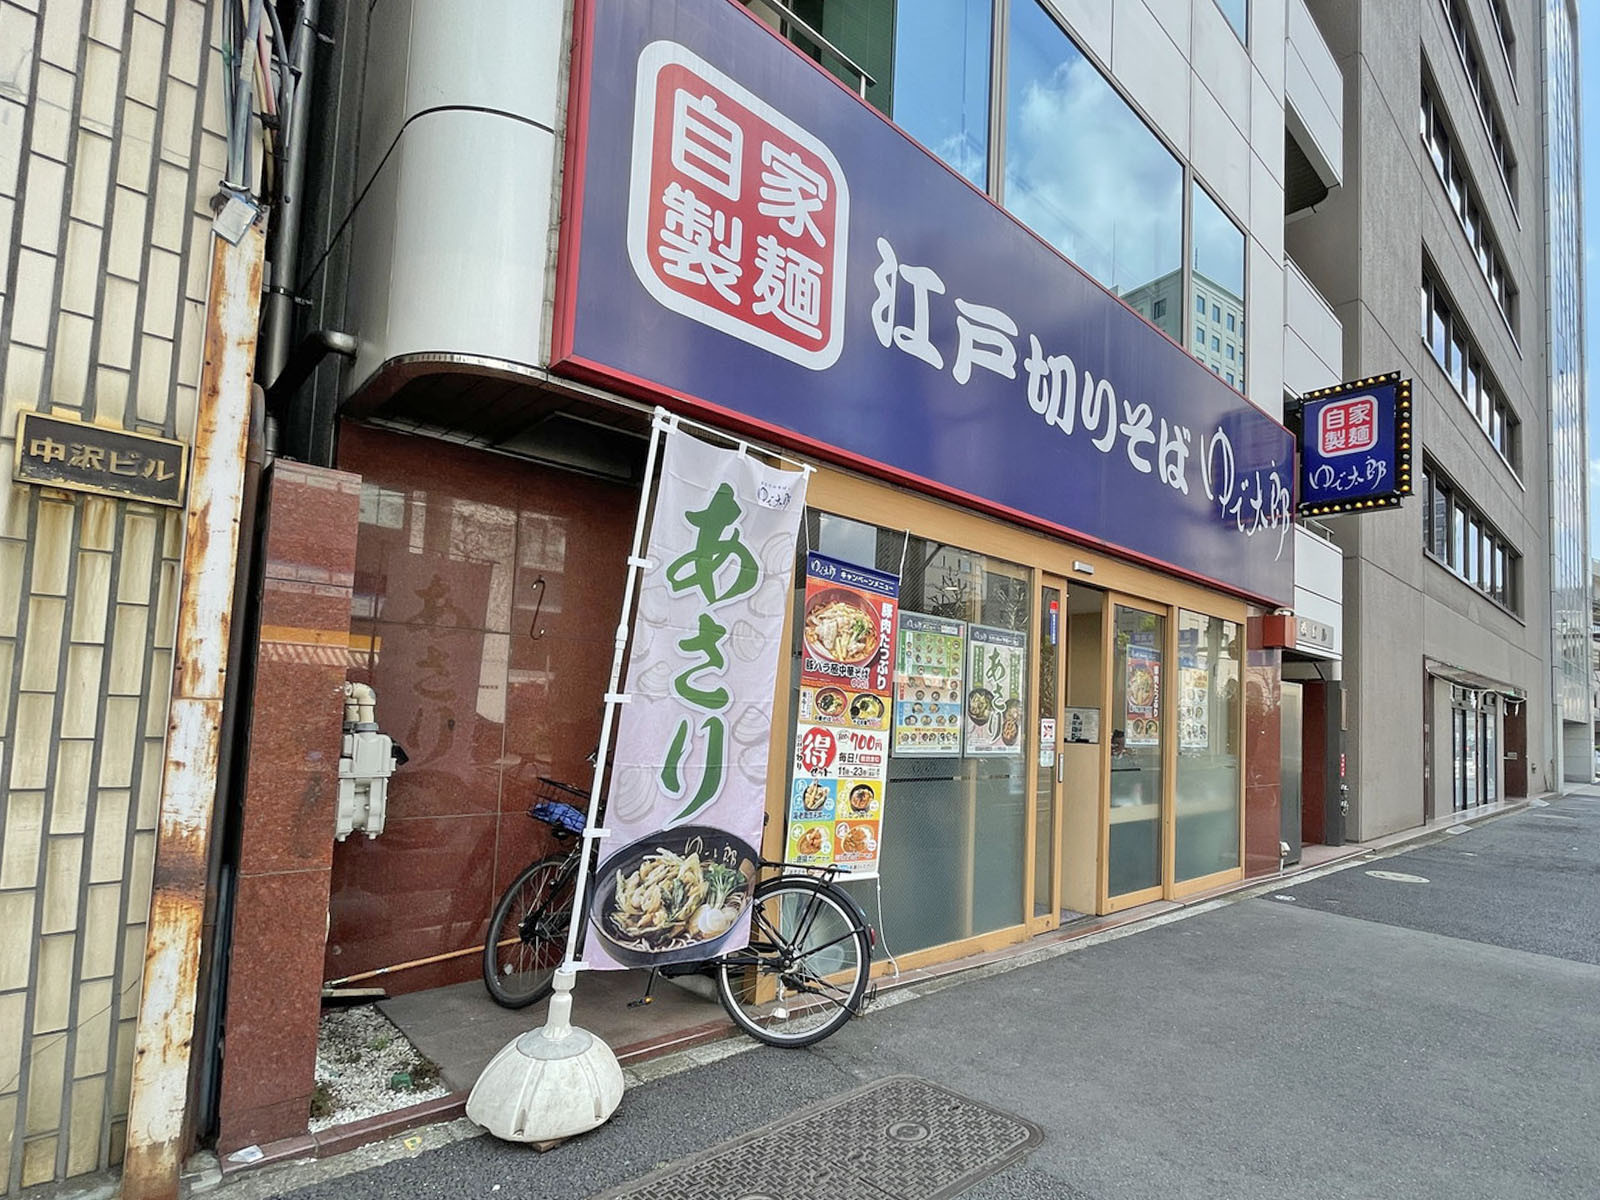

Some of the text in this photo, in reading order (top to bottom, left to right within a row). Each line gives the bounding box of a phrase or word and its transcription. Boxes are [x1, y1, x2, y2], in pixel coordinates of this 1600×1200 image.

[670, 87, 828, 249] 自家
[658, 181, 825, 341] 製麺
[870, 236, 1292, 562] 江戸切りそば ゆで太郎
[1326, 403, 1371, 430] 自家
[30, 437, 175, 482] 中沢ビル
[1324, 424, 1371, 450] 製麺
[1309, 455, 1387, 491] ゆで太郎
[661, 482, 761, 826] あさり
[985, 647, 1007, 743] あさり
[801, 733, 831, 768] 得
[849, 732, 883, 752] 700円
